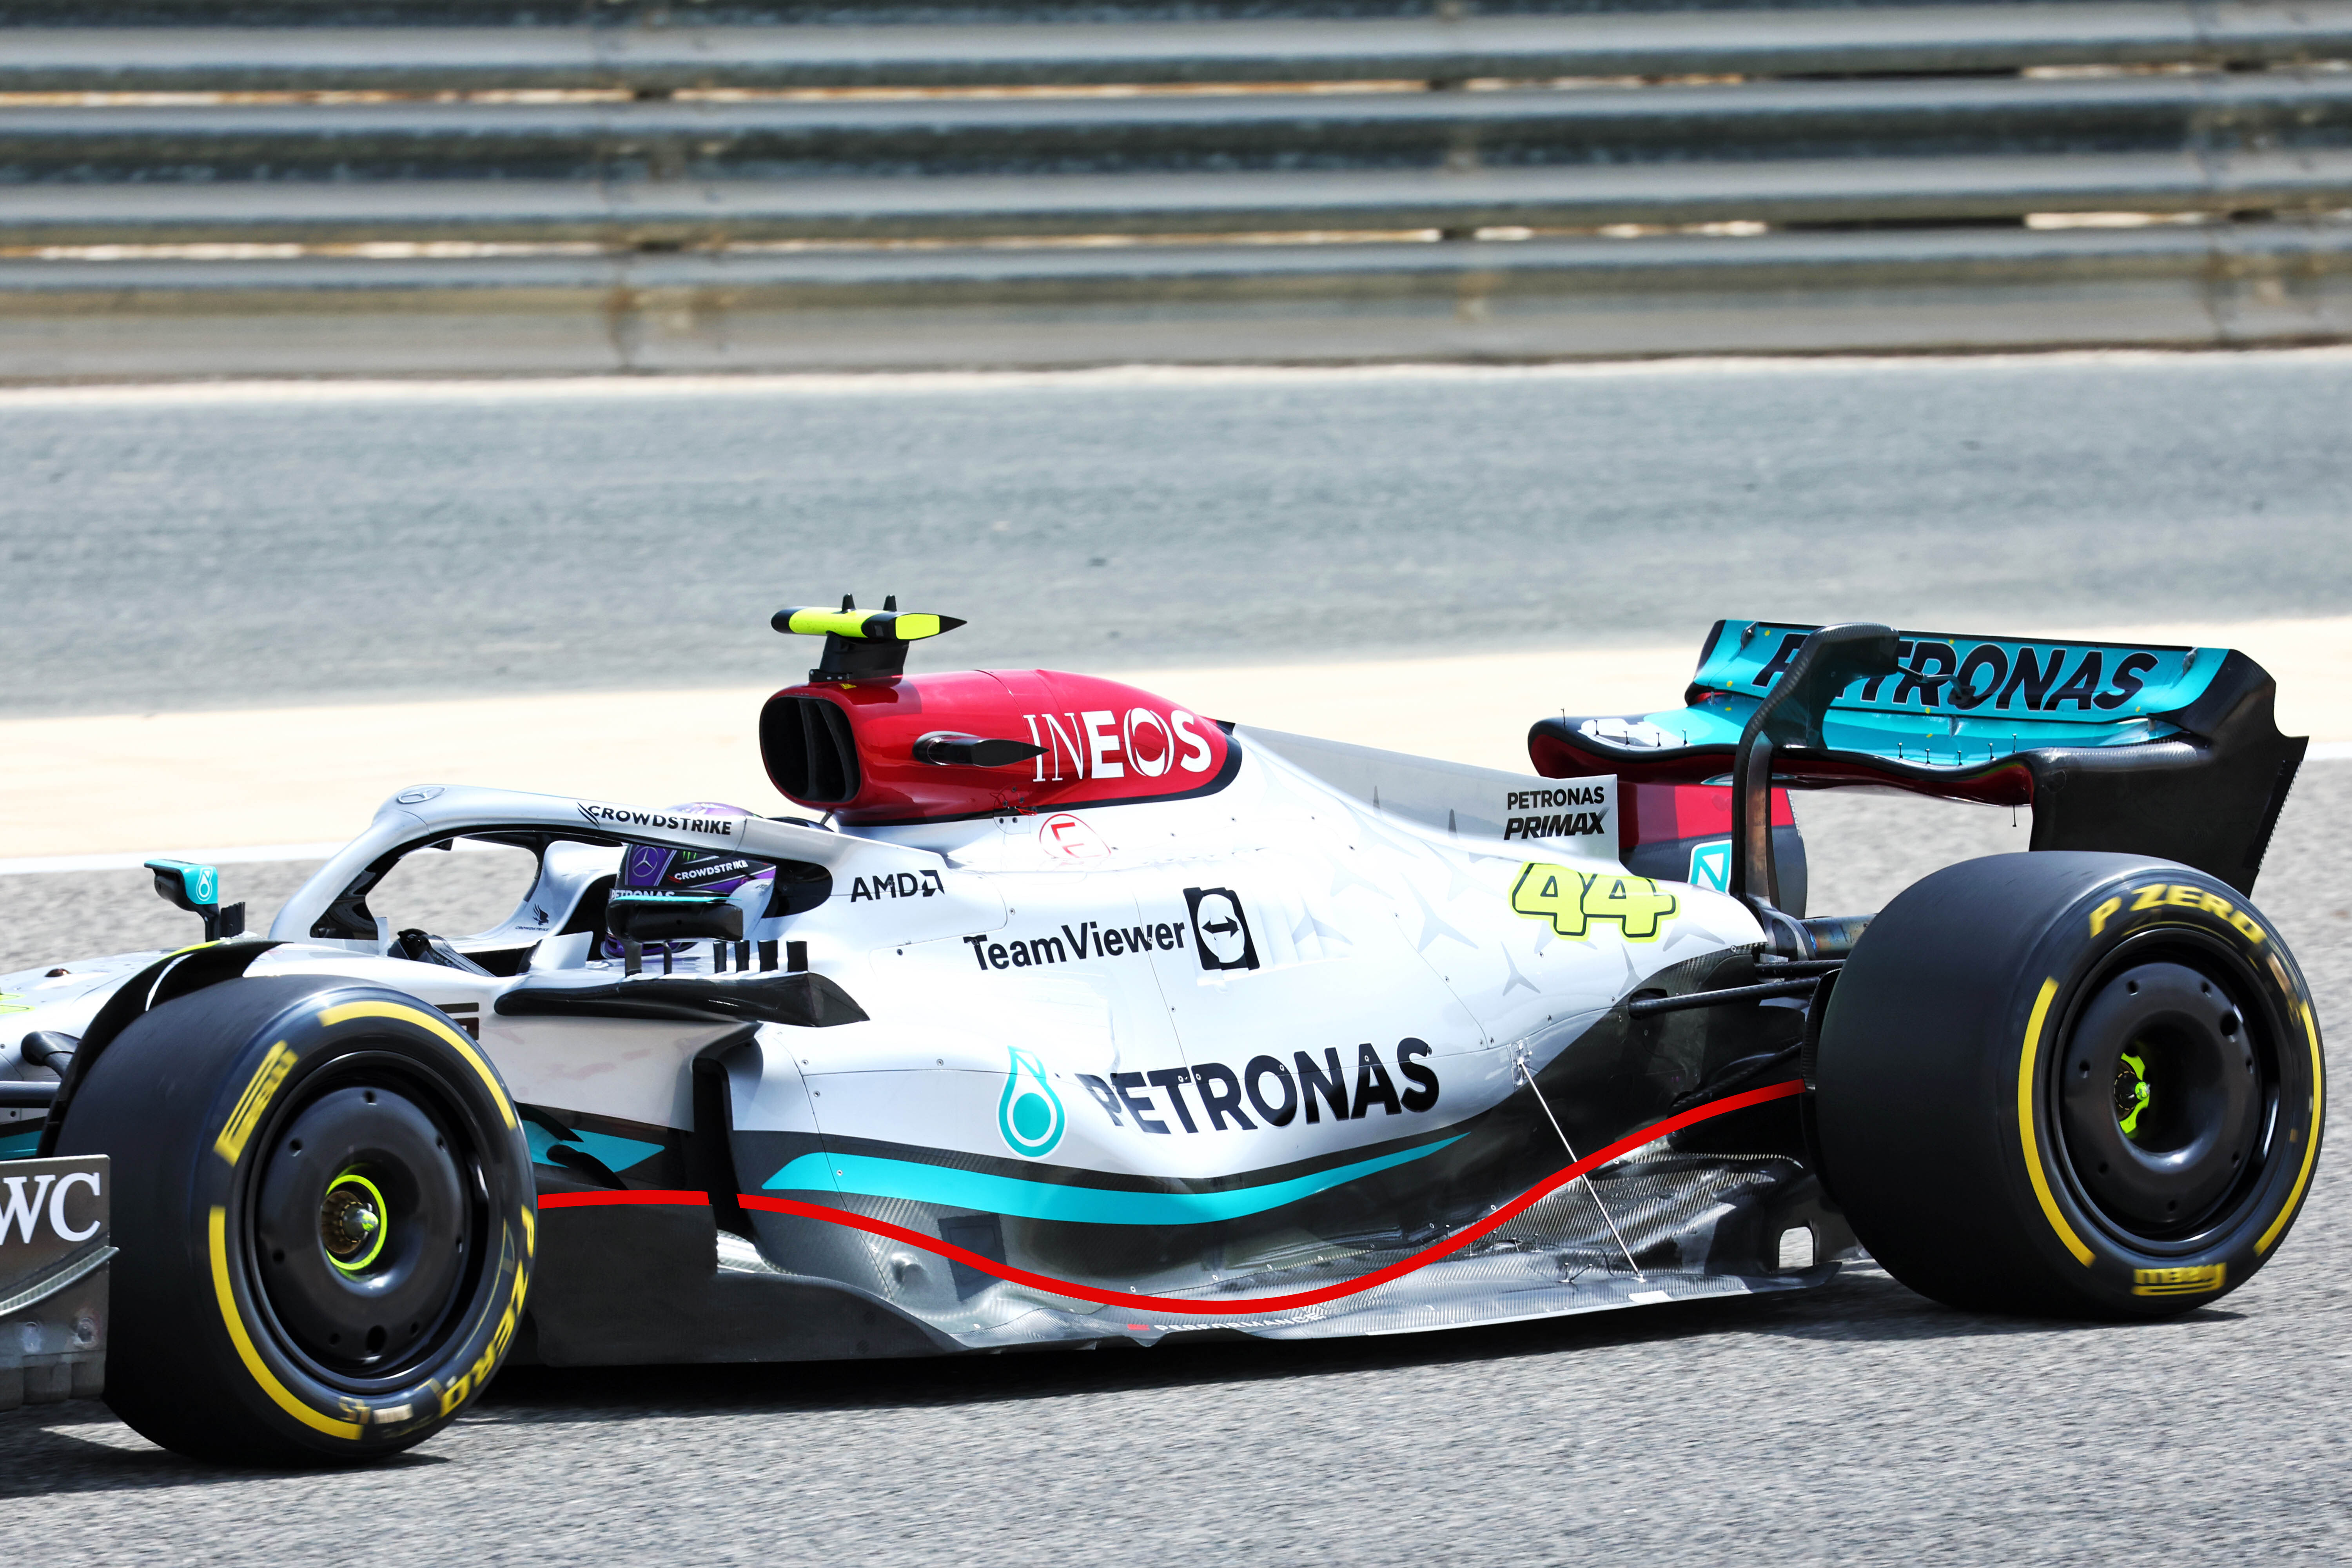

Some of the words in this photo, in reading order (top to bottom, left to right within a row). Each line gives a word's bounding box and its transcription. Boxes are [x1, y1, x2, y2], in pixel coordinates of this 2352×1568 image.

[1023, 708, 1212, 782] INEOS
[588, 806, 731, 835] CROWDSTRIKE
[1507, 787, 1604, 810] PETRONAS
[1504, 807, 1610, 840] PRIMAX
[675, 860, 748, 880] CROWDSTRIKE
[851, 873, 918, 902] AMD
[1511, 862, 1677, 938] 44
[2089, 897, 2122, 938] P
[2129, 884, 2267, 944] ZERO
[963, 921, 1185, 970] TeamViewer
[1074, 1038, 1439, 1134] PETRONAS
[440, 1259, 529, 1418] ZERO
